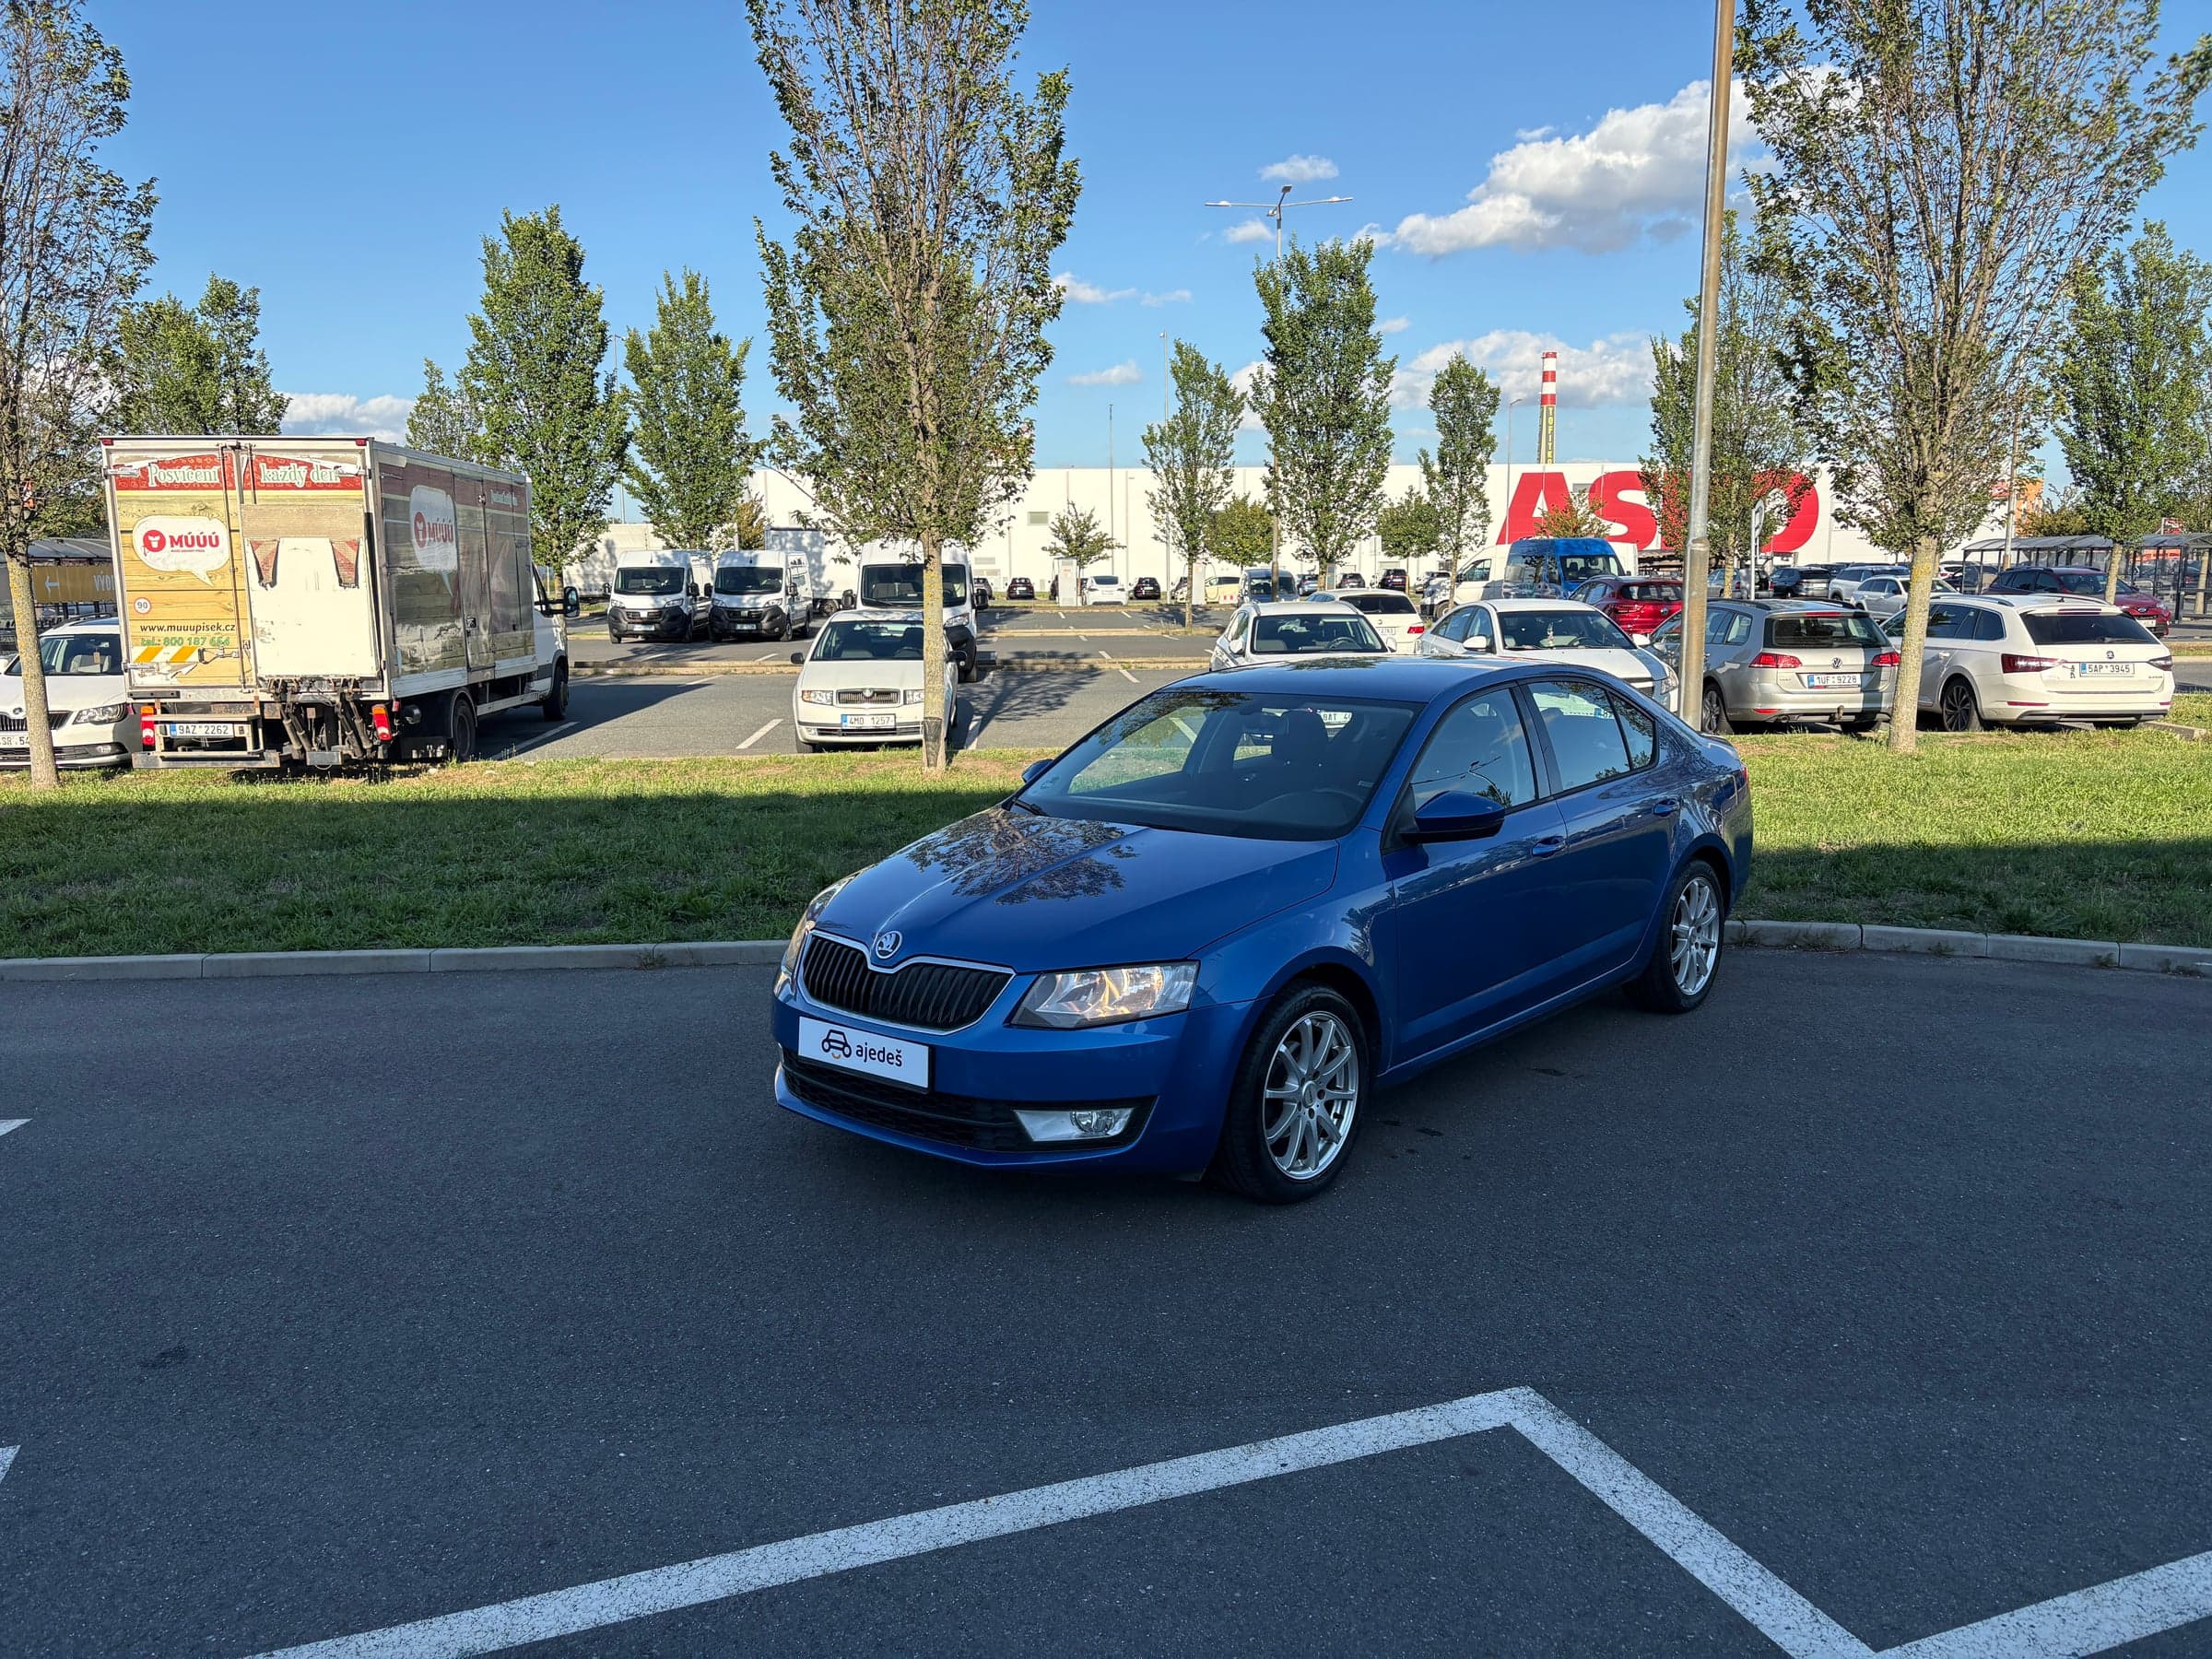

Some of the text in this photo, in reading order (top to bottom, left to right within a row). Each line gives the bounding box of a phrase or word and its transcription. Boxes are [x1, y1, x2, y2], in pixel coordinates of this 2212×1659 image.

[148, 465, 221, 487] Posvícení
[260, 463, 308, 487] každý
[428, 517, 453, 543] MÚÚÚ
[169, 532, 219, 547] MÚÚÚ
[136, 601, 148, 609] 90
[140, 622, 236, 634] www.muuupisek.cz
[163, 637, 183, 646] 800
[187, 637, 207, 646] 187
[2088, 665, 2130, 673] 5AP 3945
[871, 716, 890, 725] 1257
[179, 725, 229, 735] 9AZ 2262
[855, 1042, 902, 1067] ajedeš
